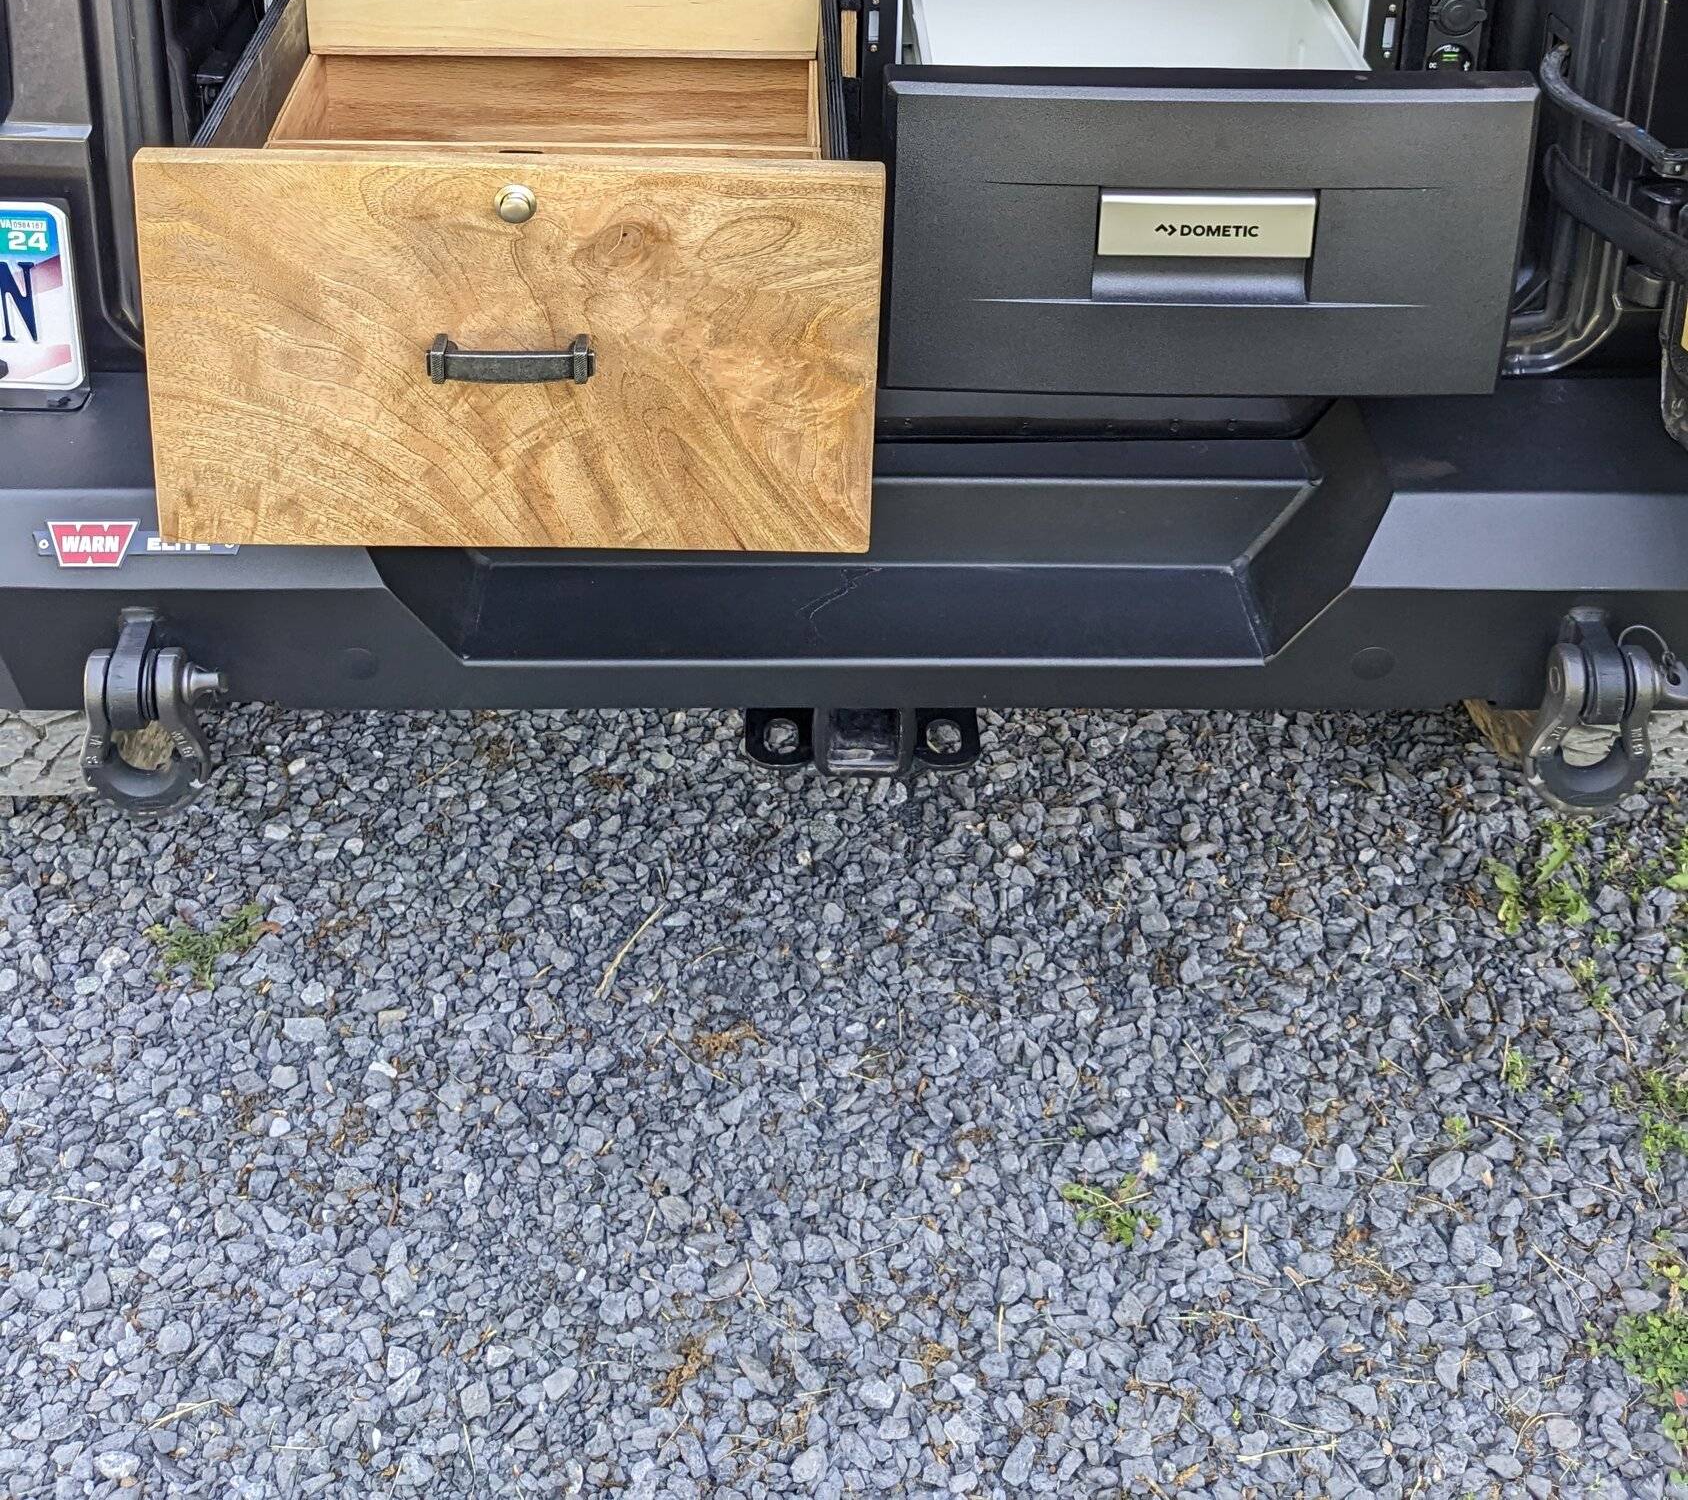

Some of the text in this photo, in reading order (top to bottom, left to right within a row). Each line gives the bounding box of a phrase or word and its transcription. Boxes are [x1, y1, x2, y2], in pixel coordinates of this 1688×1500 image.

[1180, 224, 1260, 238] DOMETIC
[7, 230, 48, 252] 24
[62, 535, 120, 553] WARN
